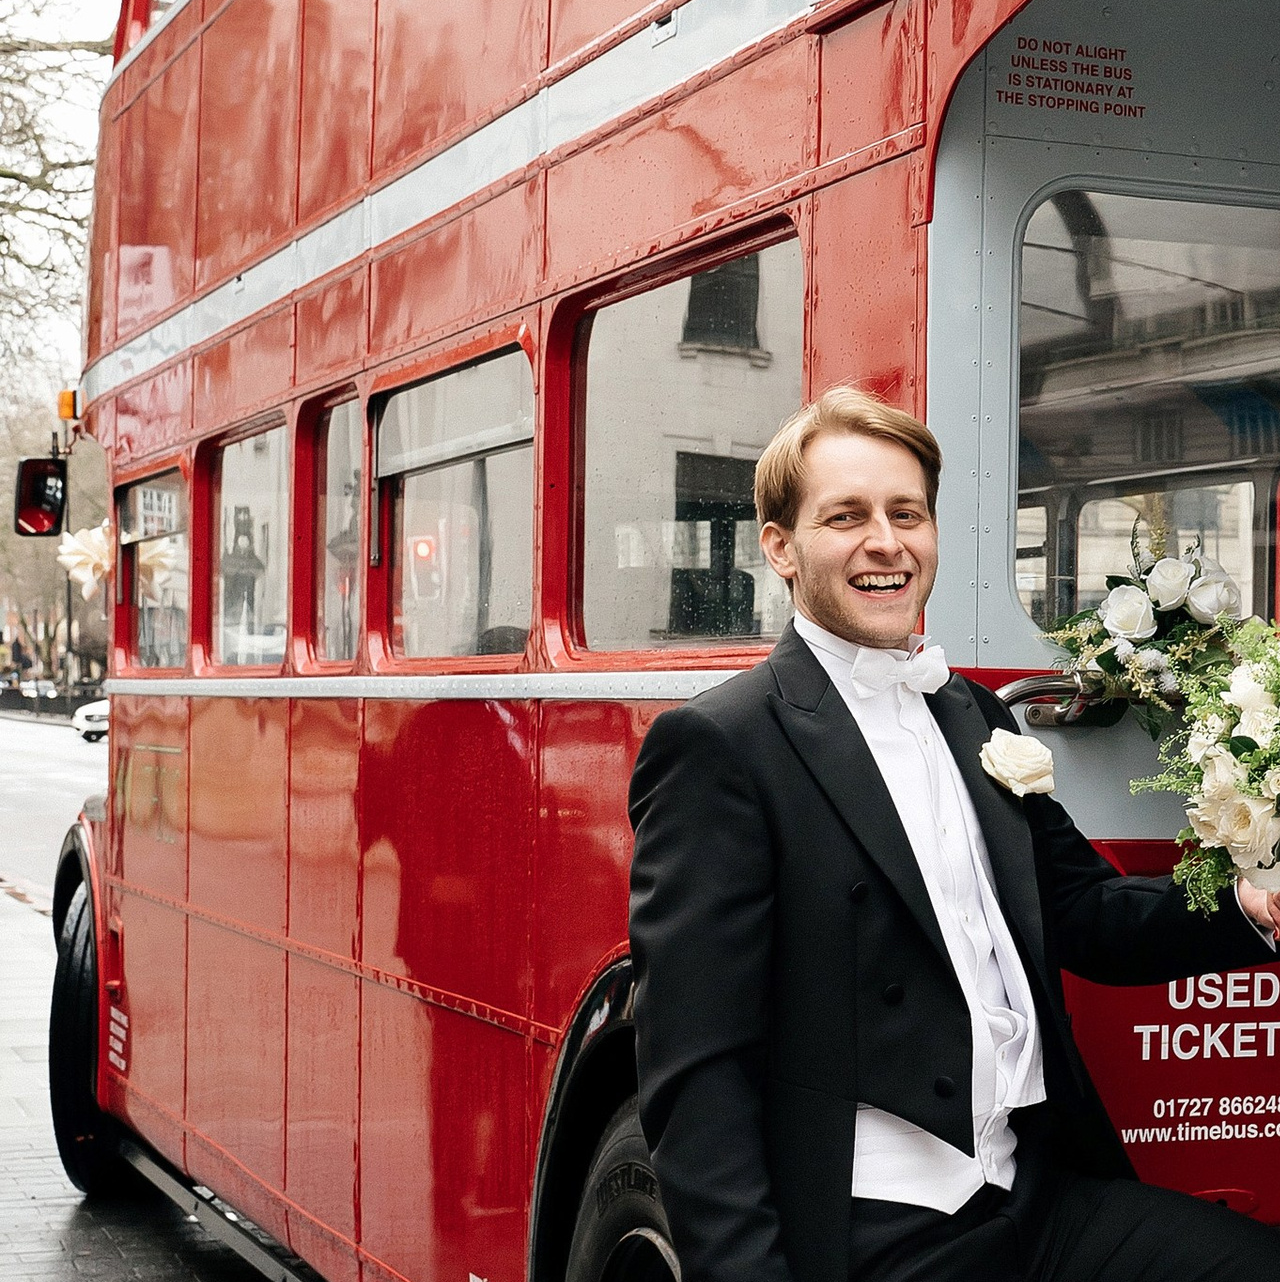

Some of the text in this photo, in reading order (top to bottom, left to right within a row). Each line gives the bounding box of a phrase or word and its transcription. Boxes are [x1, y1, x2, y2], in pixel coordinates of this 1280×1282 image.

[1017, 36, 1127, 62] DO NOT ALIGHT
[1010, 54, 1133, 81] UNLESS THE BUS
[1008, 73, 1135, 99] IS STATIONARY AT
[996, 90, 1146, 118] THE STOPPING POINT
[1168, 972, 1280, 1010] USED
[1153, 1098, 1214, 1118] 01727
